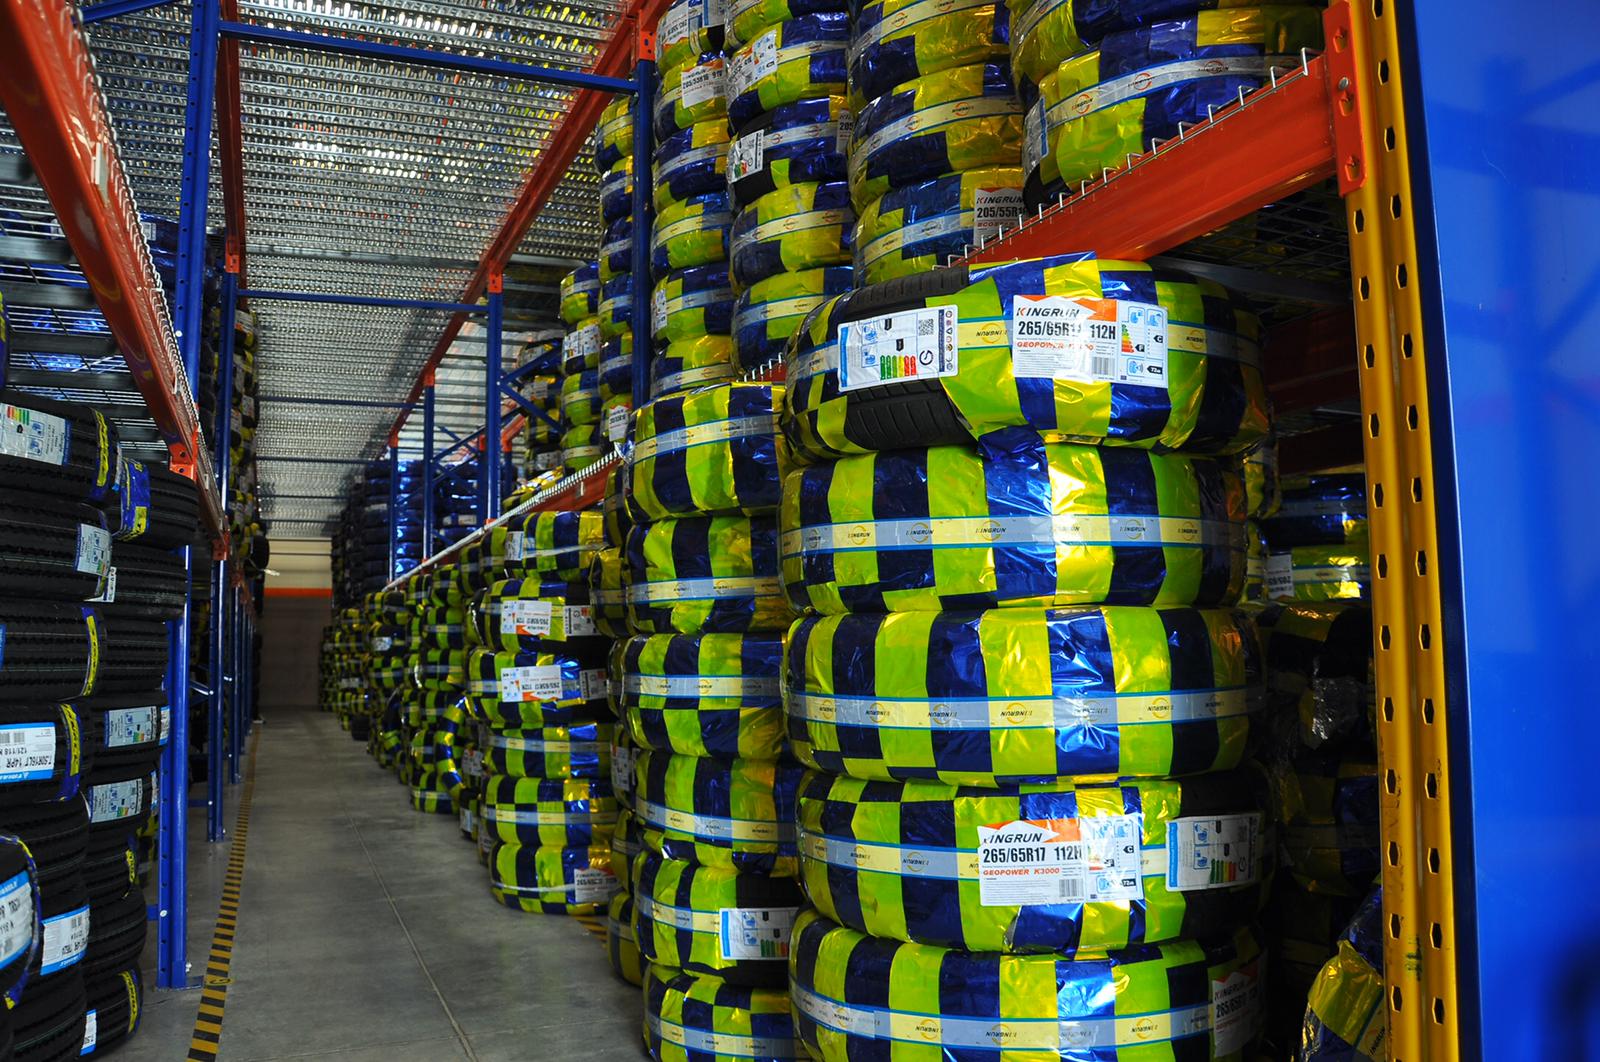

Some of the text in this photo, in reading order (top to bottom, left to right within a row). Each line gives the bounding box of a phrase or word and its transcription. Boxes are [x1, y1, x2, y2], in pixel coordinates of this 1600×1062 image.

[1016, 306, 1080, 318] KINGRUN
[1090, 324, 1116, 340] 112H
[983, 848, 1046, 863] 265/65R17
[983, 868, 1030, 876] GEOPOWER
